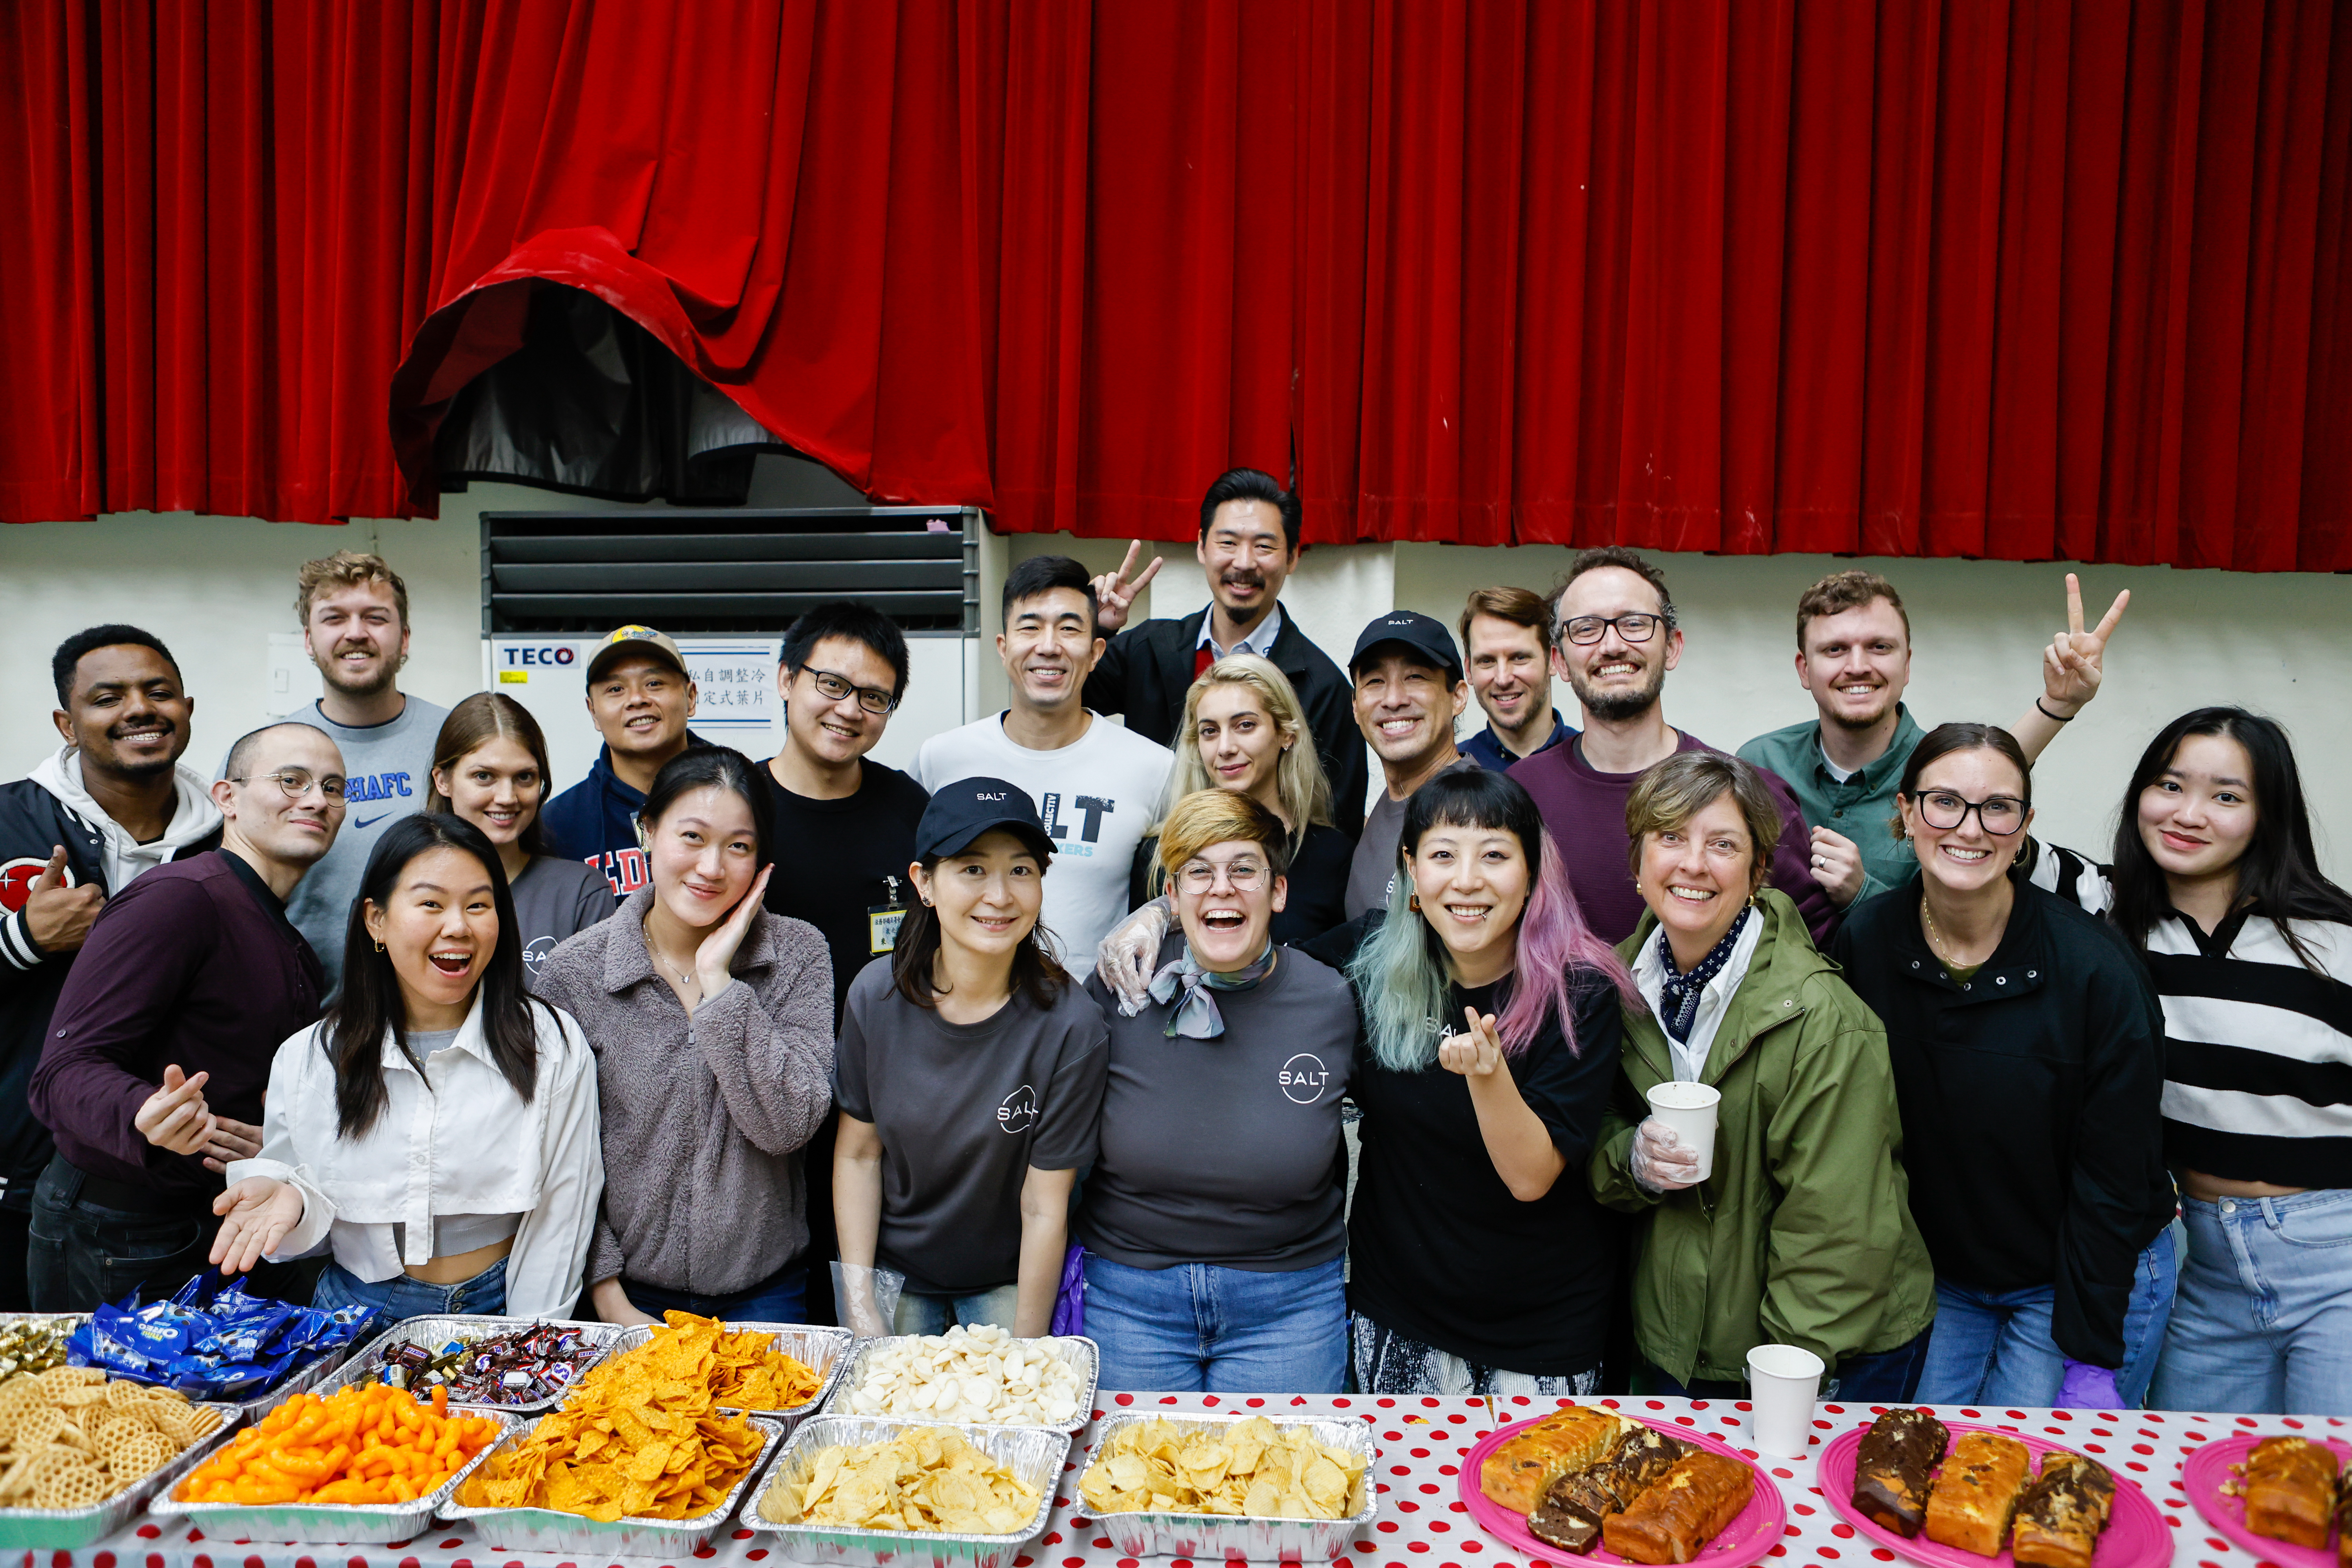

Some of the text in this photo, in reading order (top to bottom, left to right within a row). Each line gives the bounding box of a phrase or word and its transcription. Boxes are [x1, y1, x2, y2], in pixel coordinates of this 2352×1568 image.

[504, 648, 574, 664] TECO
[689, 668, 766, 683] 私自調整冷
[696, 690, 762, 705] 定式葉片
[1040, 792, 1115, 843] LT
[1055, 843, 1093, 857] KERS
[522, 951, 546, 962] SA
[1279, 1071, 1329, 1085] SALT
[997, 1101, 1039, 1123] SALT
[138, 1323, 179, 1338] OREO
[405, 1347, 428, 1358] SNICKERS
